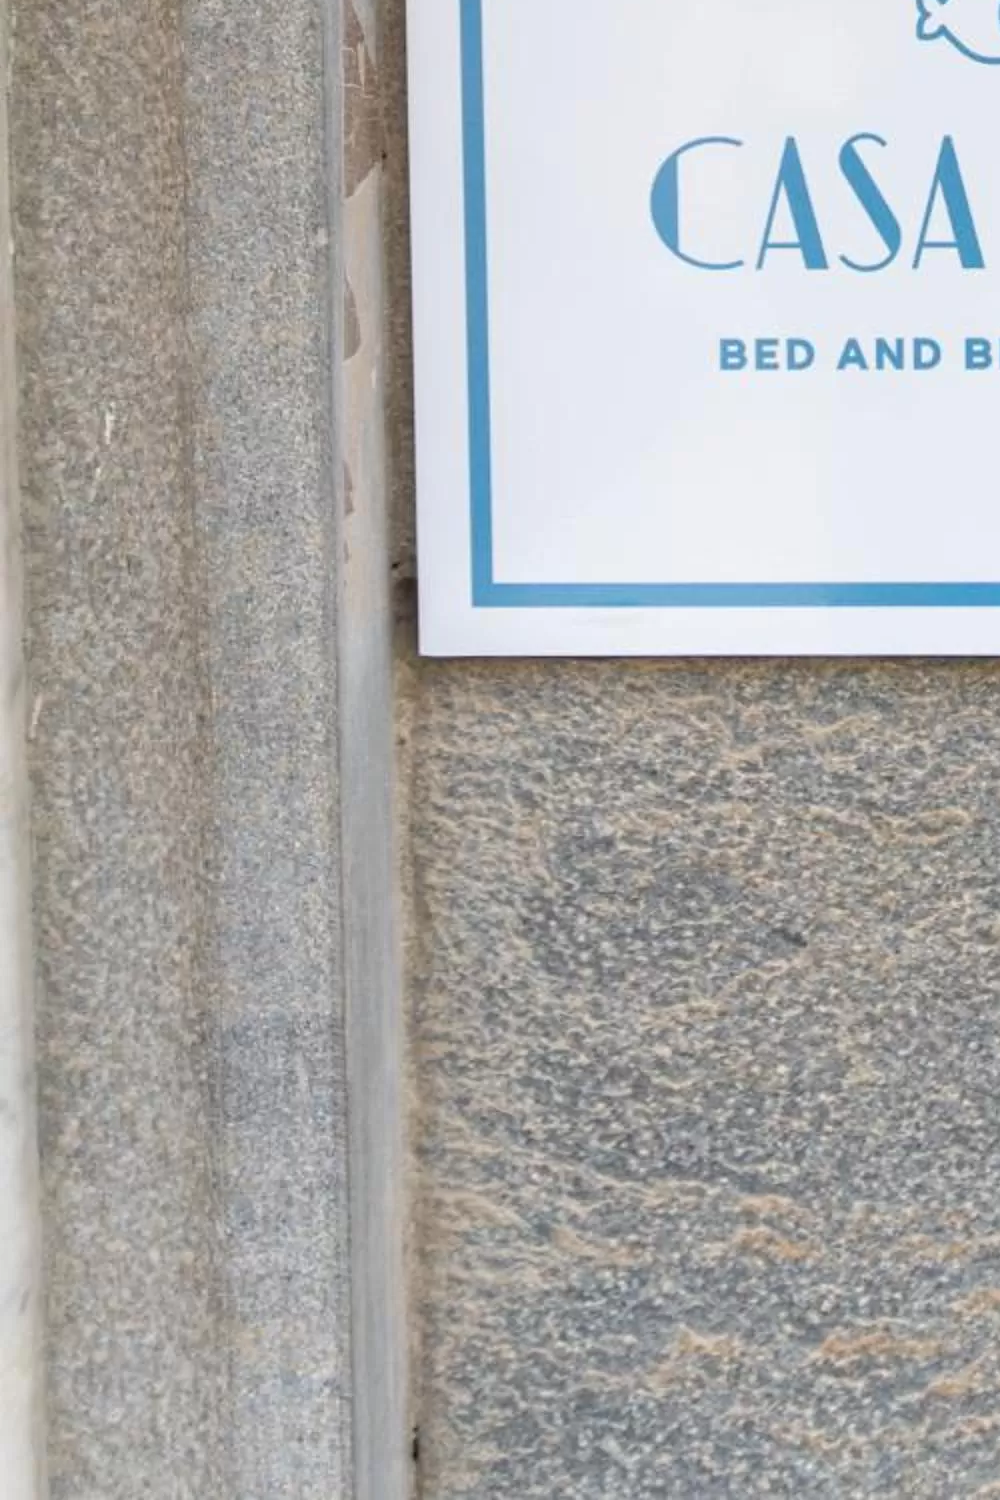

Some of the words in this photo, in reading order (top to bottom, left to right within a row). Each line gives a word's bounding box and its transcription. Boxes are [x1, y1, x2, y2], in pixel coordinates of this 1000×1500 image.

[649, 132, 985, 272] CASA
[718, 337, 817, 372] BED
[836, 336, 944, 372] AND
